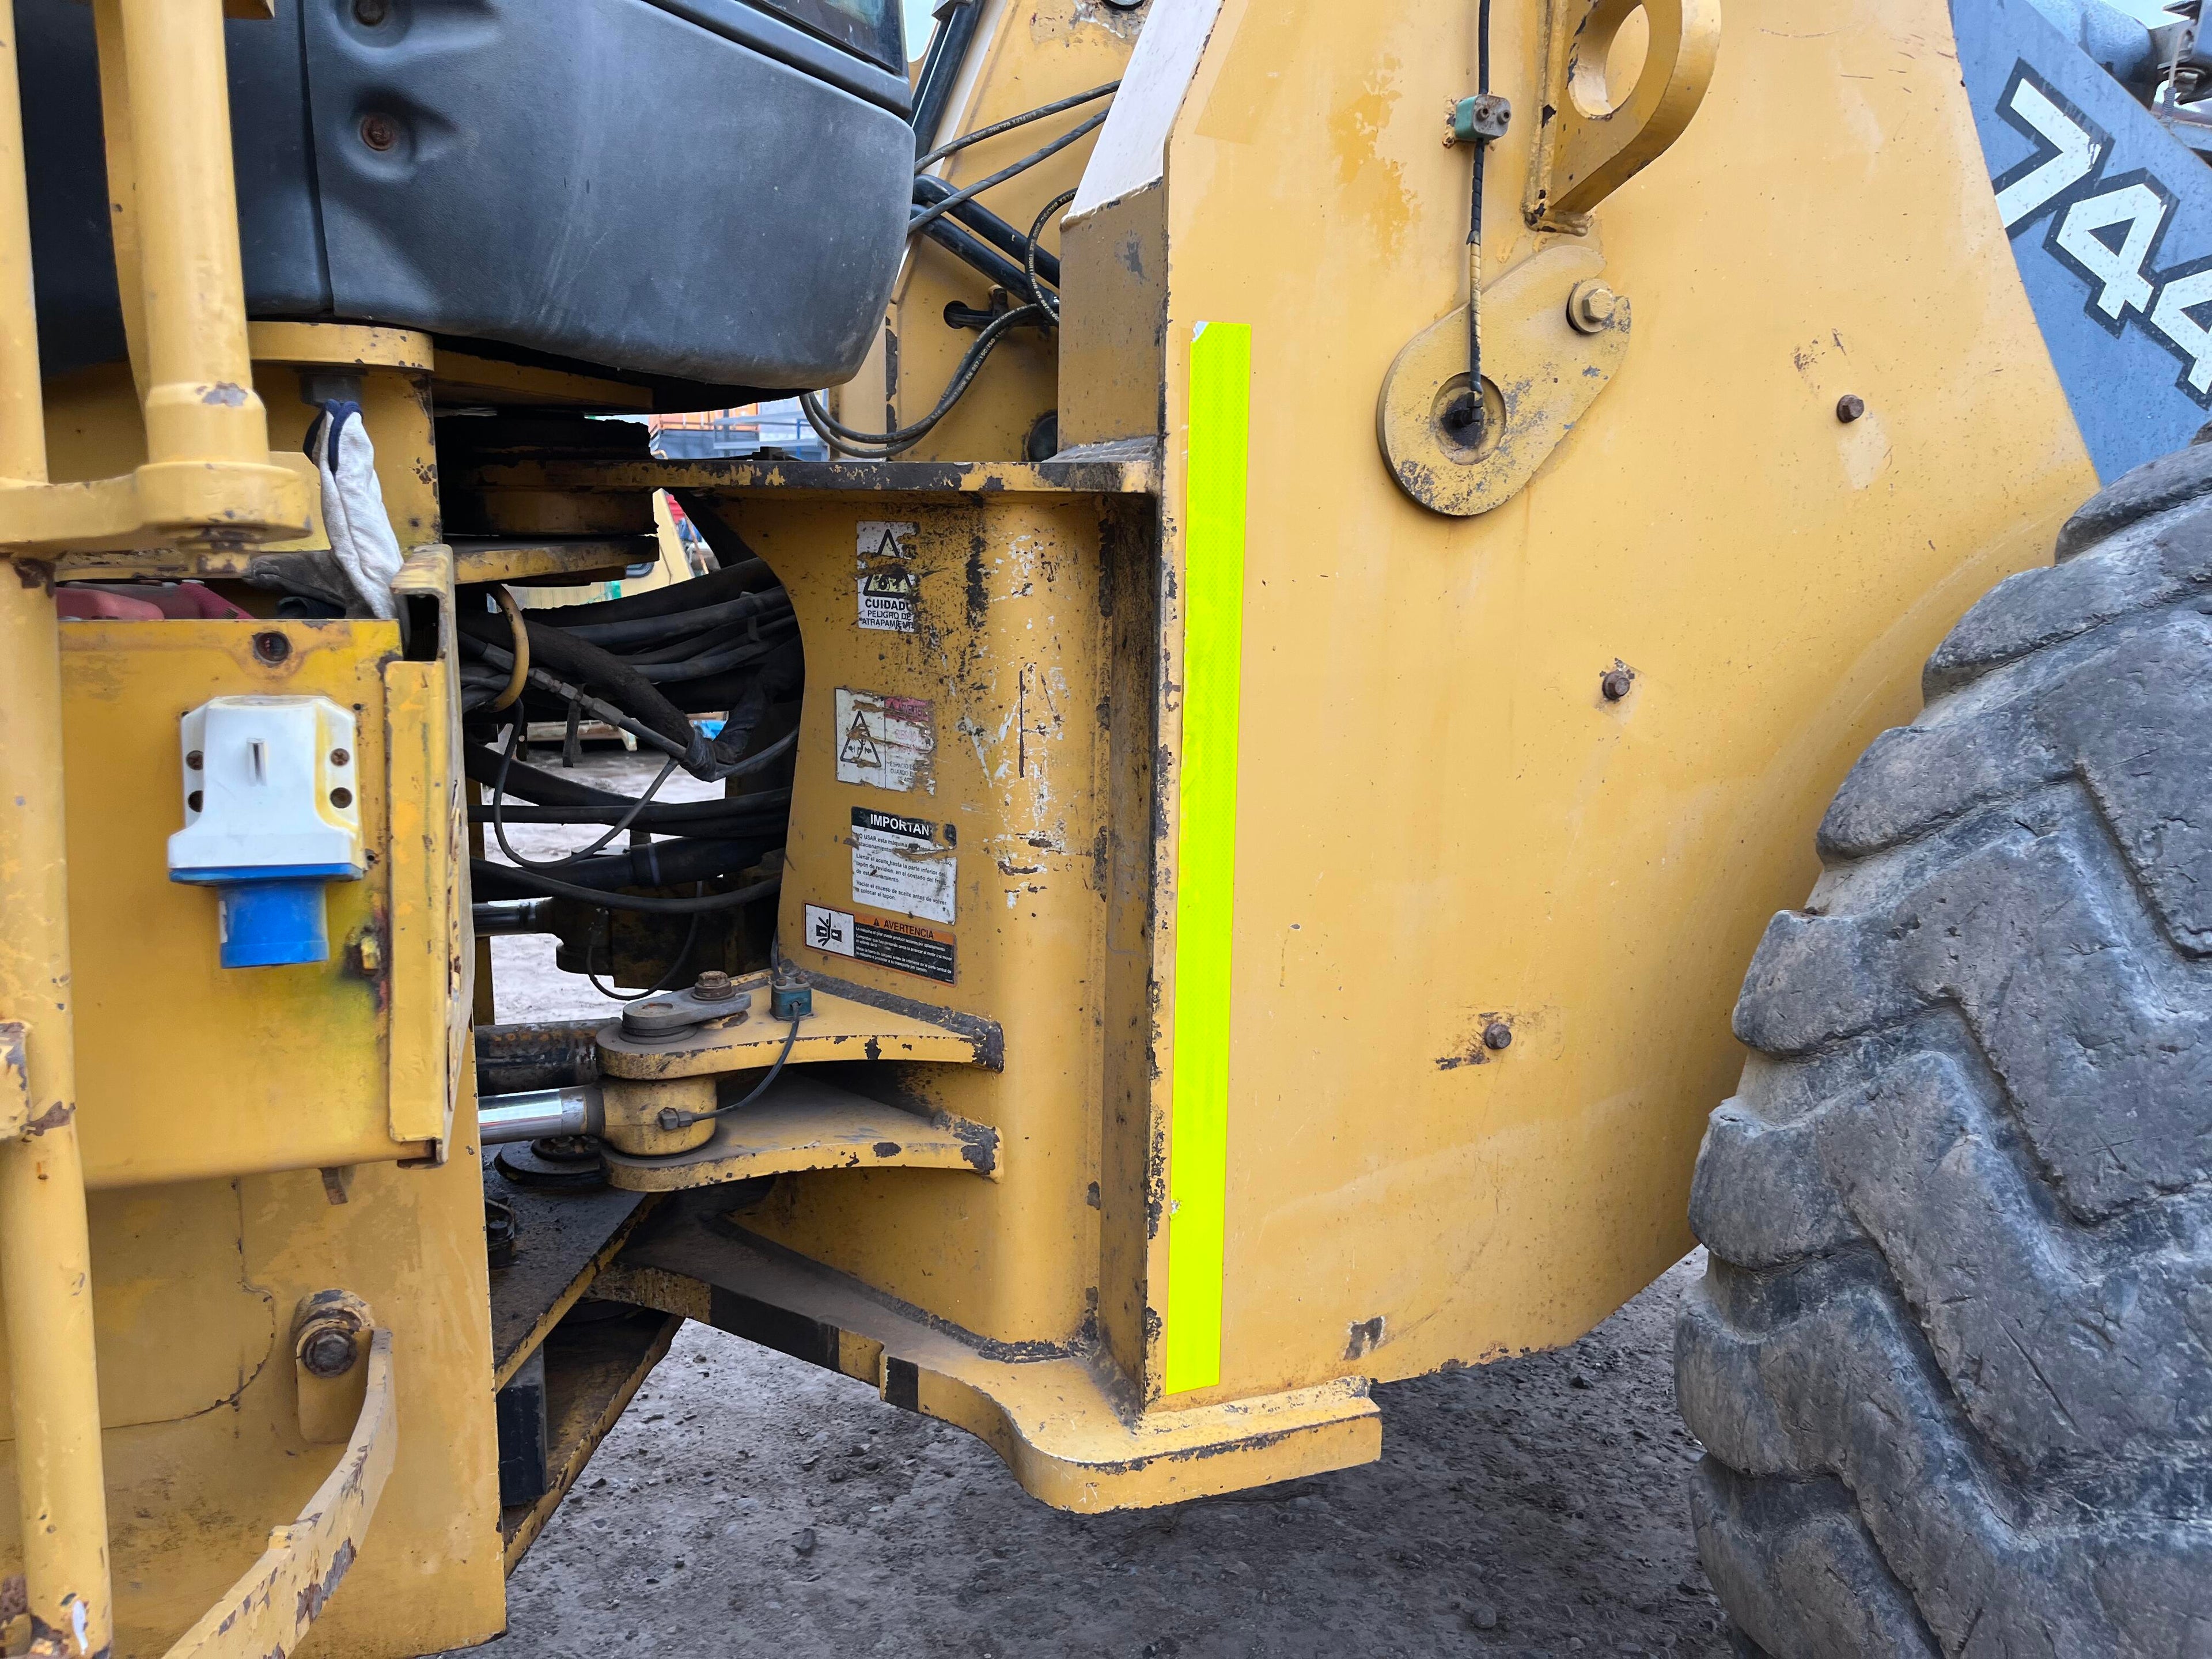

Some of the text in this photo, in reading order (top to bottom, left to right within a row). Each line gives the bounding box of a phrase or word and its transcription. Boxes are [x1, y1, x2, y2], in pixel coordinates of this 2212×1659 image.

[868, 610, 899, 619] PELIGRO
[870, 814, 930, 836] IMPORTAN
[858, 842, 892, 852] stacionamiento
[921, 867, 938, 875] inferior
[907, 873, 926, 881] costado
[856, 880, 869, 888] Vaciar
[884, 919, 934, 940] AVERTENCIA
